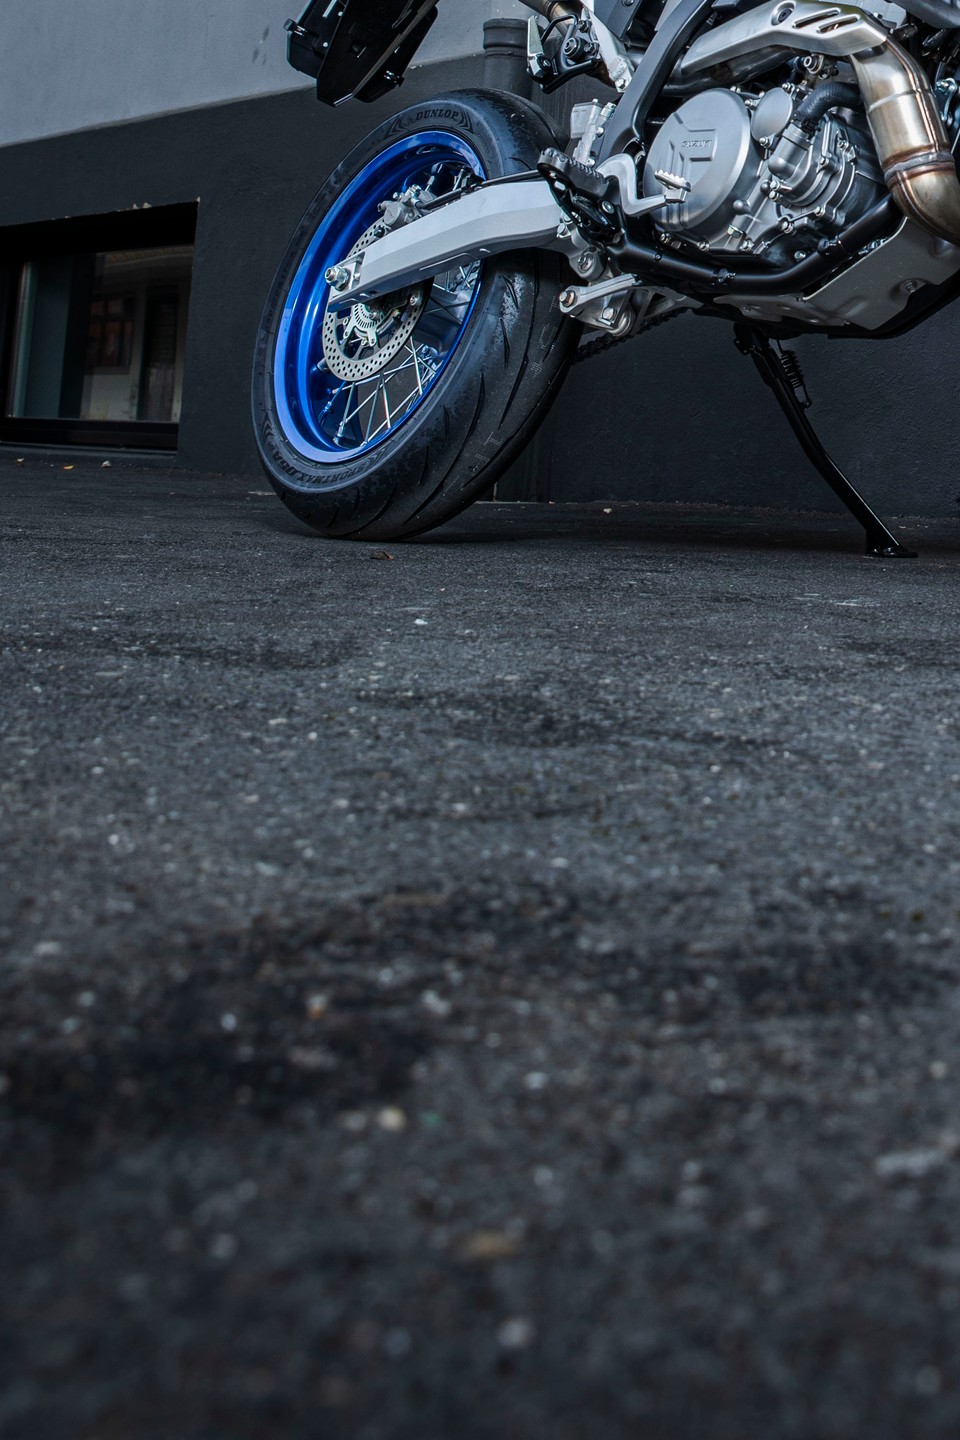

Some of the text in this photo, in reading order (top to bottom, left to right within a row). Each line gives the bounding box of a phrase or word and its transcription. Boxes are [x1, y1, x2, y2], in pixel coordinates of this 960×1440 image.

[414, 108, 460, 121] DUNLOP
[681, 139, 713, 149] SUZUKI
[299, 465, 365, 484] SPORTMAX
